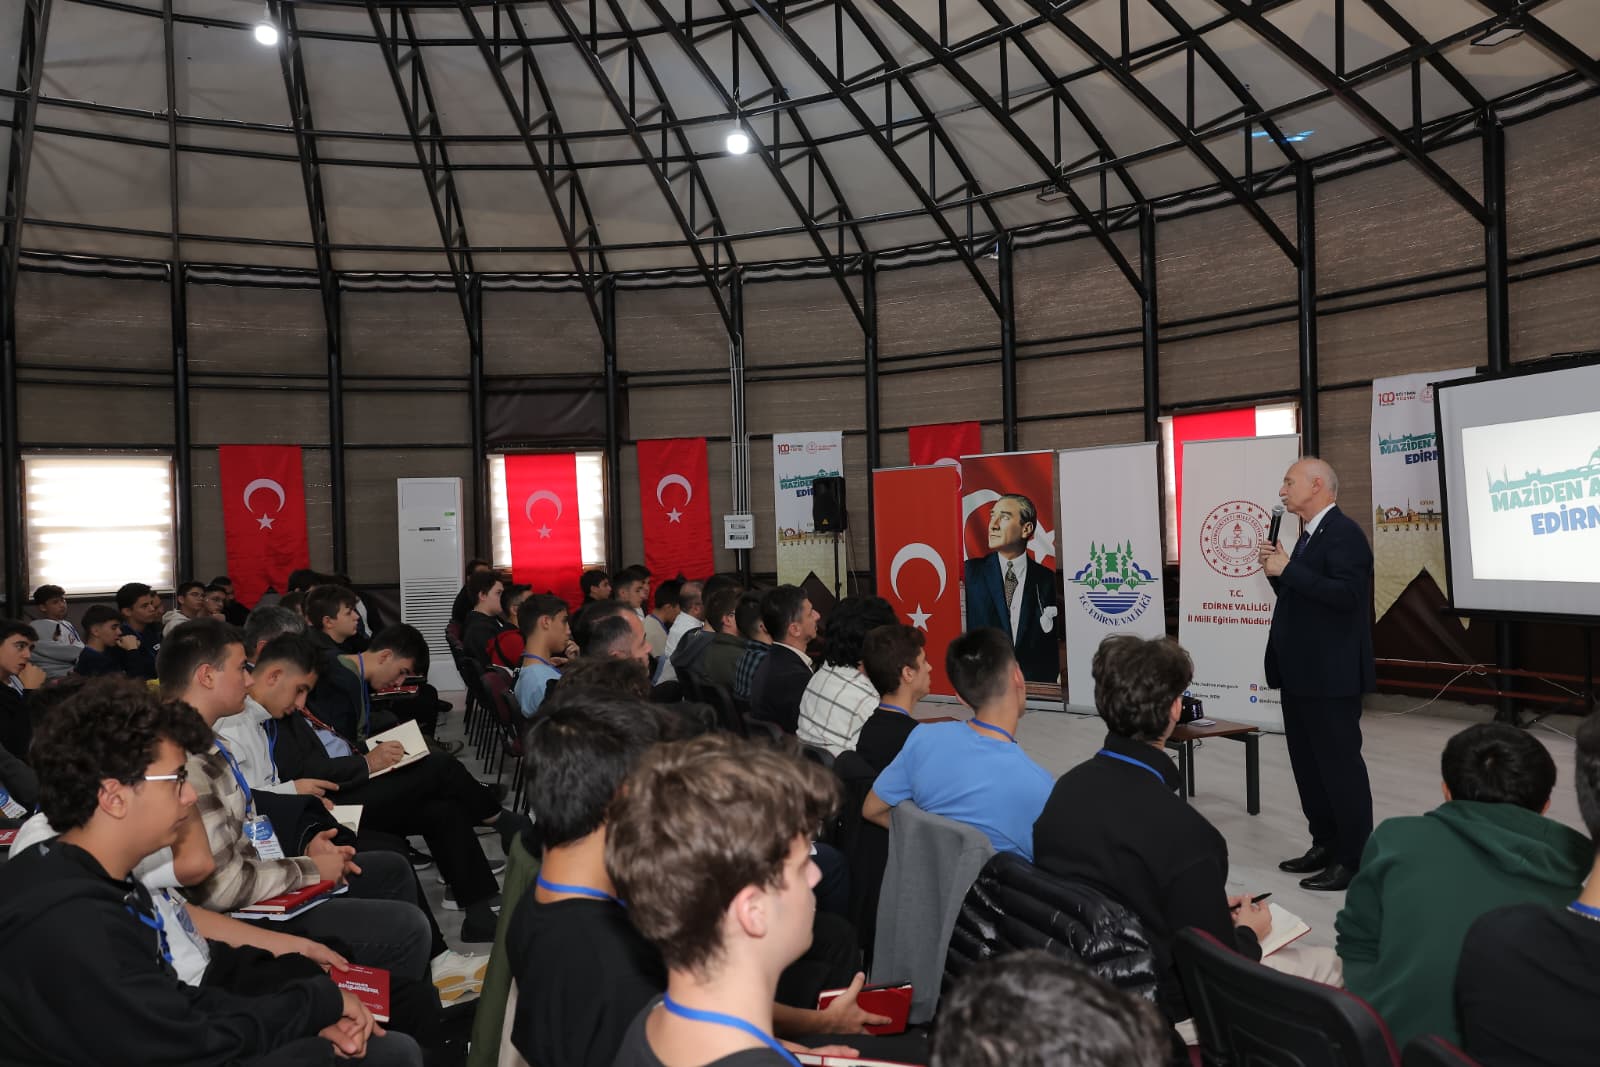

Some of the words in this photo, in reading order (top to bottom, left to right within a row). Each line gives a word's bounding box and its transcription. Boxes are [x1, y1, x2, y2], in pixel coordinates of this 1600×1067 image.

[1380, 440, 1431, 455] MAZİDEN
[1491, 480, 1583, 512] MAZİDEN
[1531, 504, 1600, 535] EDİRN
[1229, 589, 1244, 598] T.C.
[1202, 601, 1233, 611] EDİRNE
[1235, 602, 1271, 612] VALİLİĞİ
[1213, 616, 1239, 625] Eğitim
